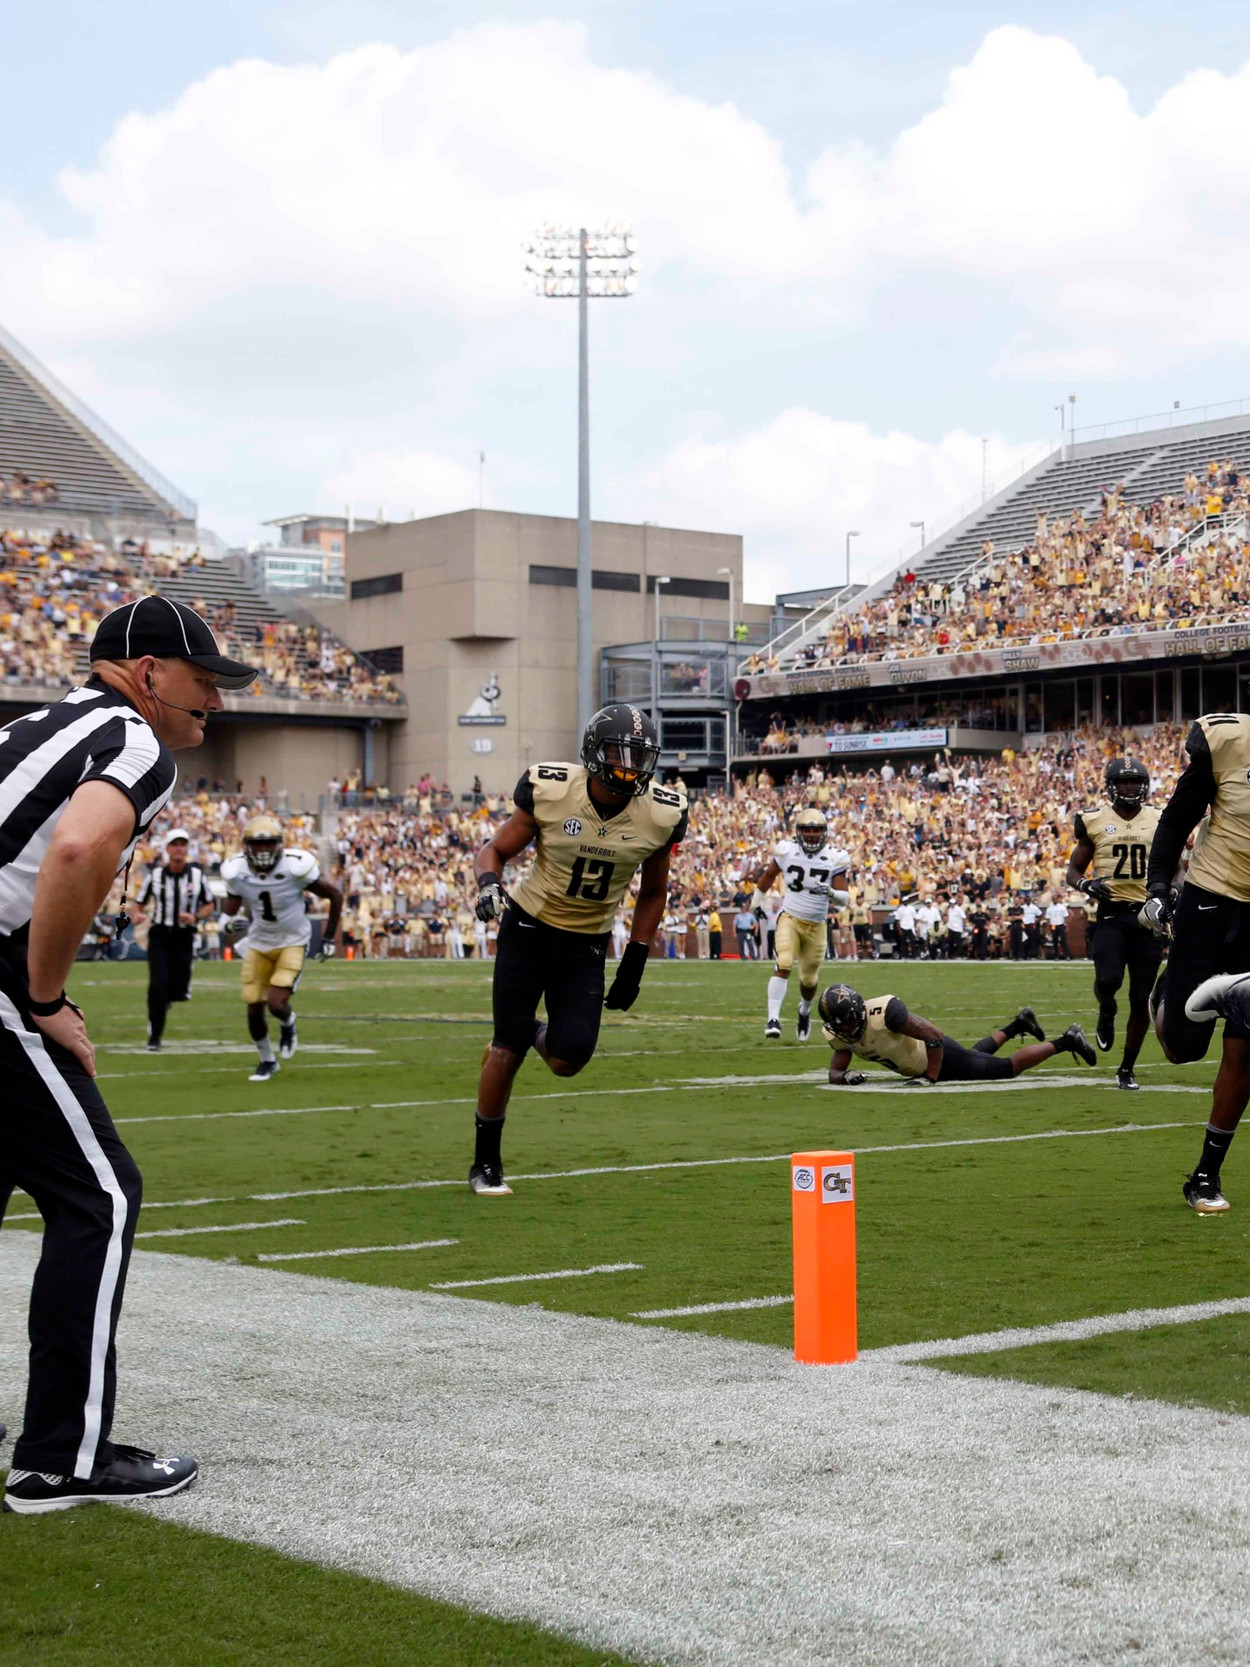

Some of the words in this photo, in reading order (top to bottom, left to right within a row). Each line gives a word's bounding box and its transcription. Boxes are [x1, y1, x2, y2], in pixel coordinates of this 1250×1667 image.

[1174, 628, 1210, 639] COLLEGE
[1164, 639, 1205, 657] HALL
[1205, 637, 1224, 652] OF
[1004, 657, 1039, 673] SHAW
[789, 680, 818, 694] HALL
[819, 678, 835, 689] OF
[837, 674, 870, 687] FAME
[1206, 715, 1240, 727] 11
[538, 765, 568, 782] 13
[563, 819, 582, 836] SEC
[579, 844, 616, 858] VANDERBILT
[1112, 844, 1147, 880] 20
[566, 857, 615, 901] 13
[787, 865, 829, 895] 37
[258, 891, 277, 922] 1
[869, 1007, 882, 1016] 5
[797, 1173, 810, 1182] ACC
[823, 1173, 851, 1194] GT
